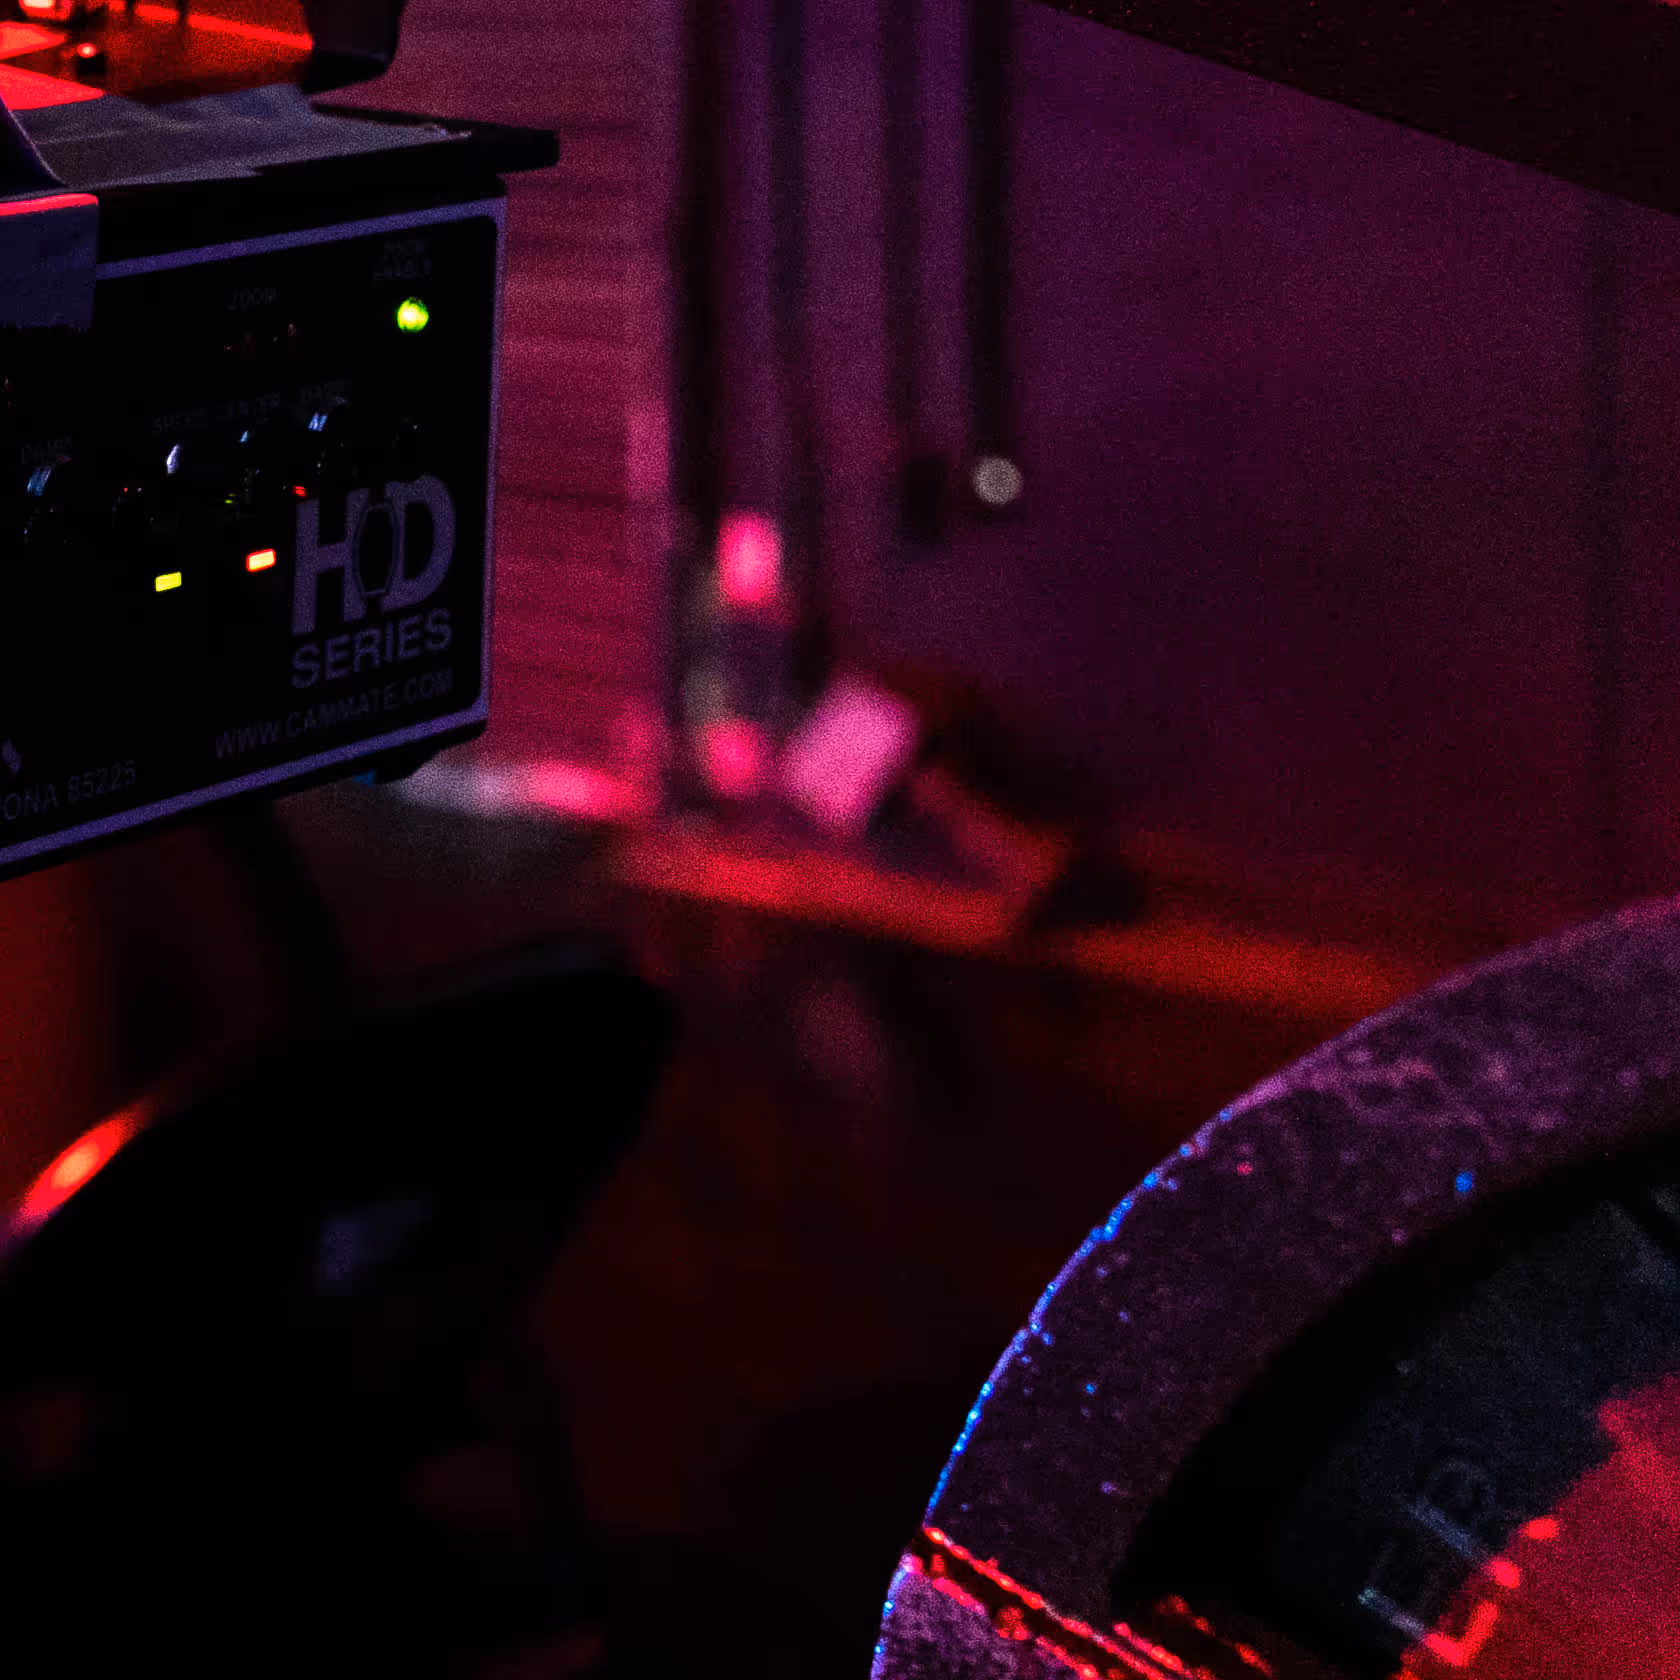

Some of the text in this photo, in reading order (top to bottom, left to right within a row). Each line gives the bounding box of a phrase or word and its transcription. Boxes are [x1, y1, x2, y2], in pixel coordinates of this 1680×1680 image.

[290, 471, 458, 639] HD
[290, 608, 455, 690] SERIES
[214, 665, 455, 760] WWW.CAMMATE.COM
